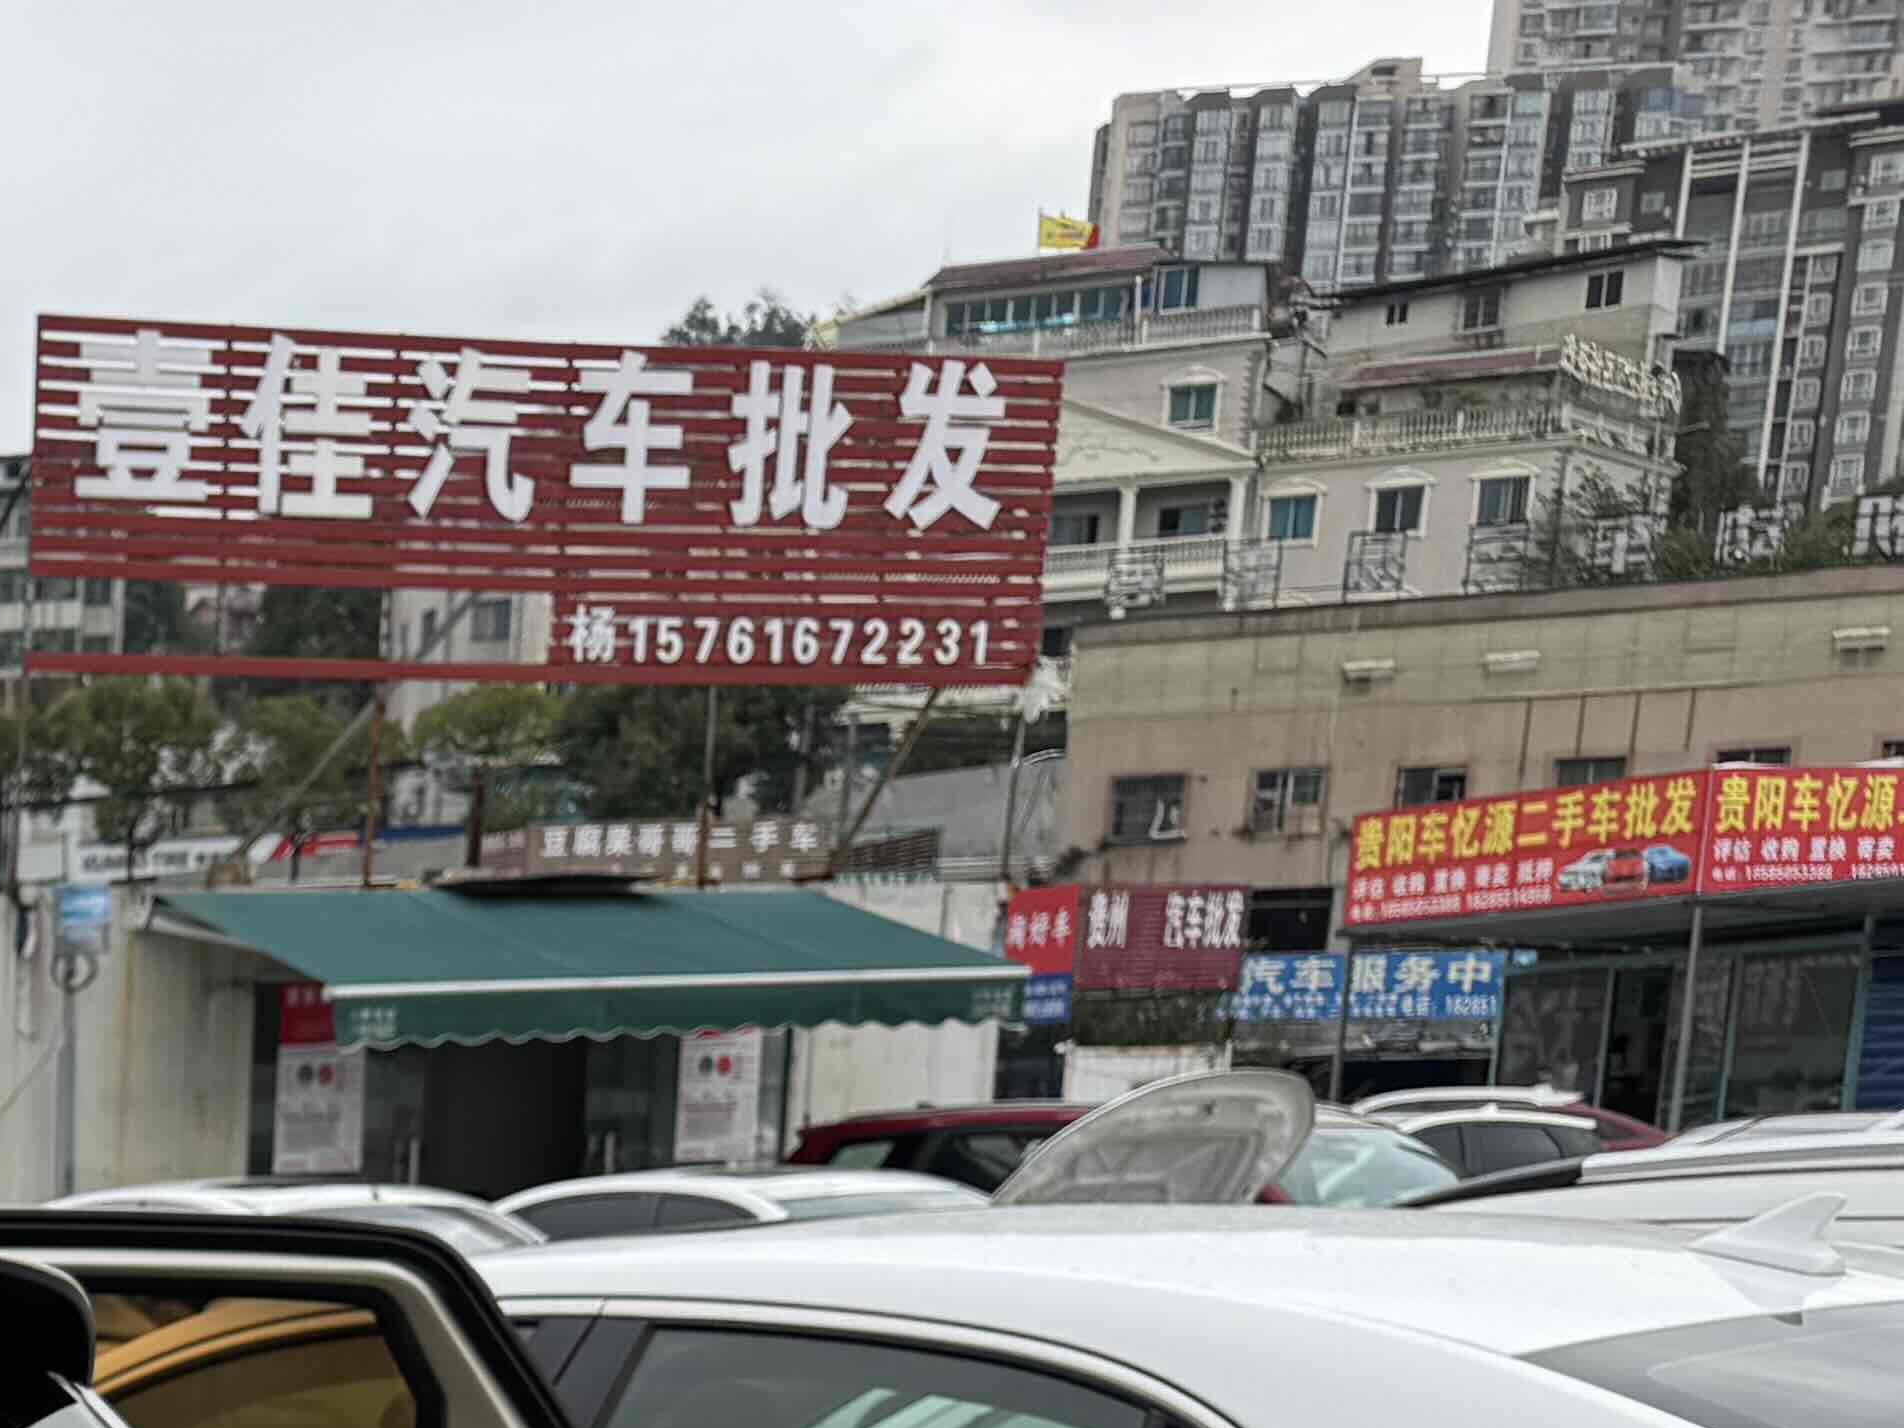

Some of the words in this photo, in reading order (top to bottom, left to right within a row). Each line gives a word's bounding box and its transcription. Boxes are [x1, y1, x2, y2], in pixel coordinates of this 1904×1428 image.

[74, 329, 1008, 531] 壹佳汽车批发
[1355, 777, 1696, 870] 贵阳车忆源二手车批发
[1714, 773, 1904, 832] 贵阳车忆源
